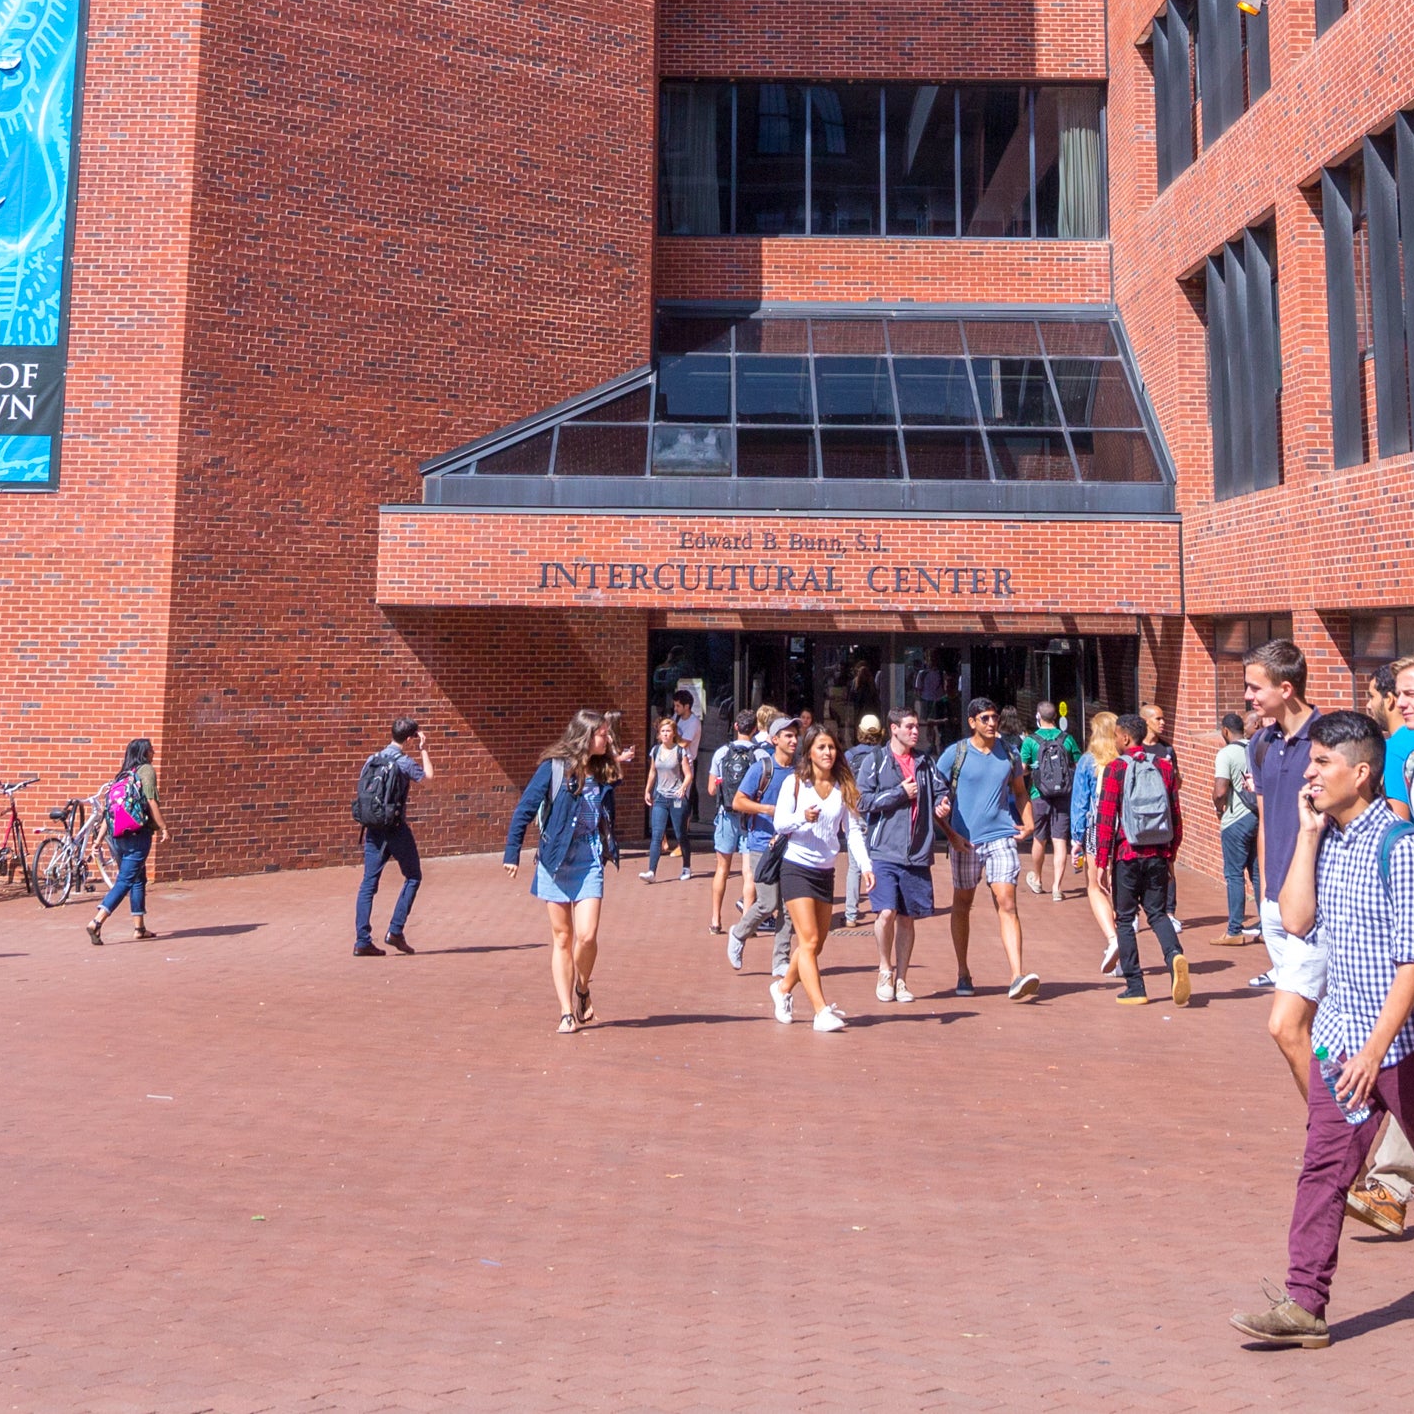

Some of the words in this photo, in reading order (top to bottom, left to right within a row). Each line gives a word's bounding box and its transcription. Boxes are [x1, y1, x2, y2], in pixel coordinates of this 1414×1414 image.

[679, 531, 753, 550] Edward
[762, 532, 781, 550] B.
[789, 533, 848, 554] Bunn,
[855, 533, 887, 553] S.J.
[538, 562, 843, 592] INTERCULTURAL
[866, 565, 1016, 596] CENTER
